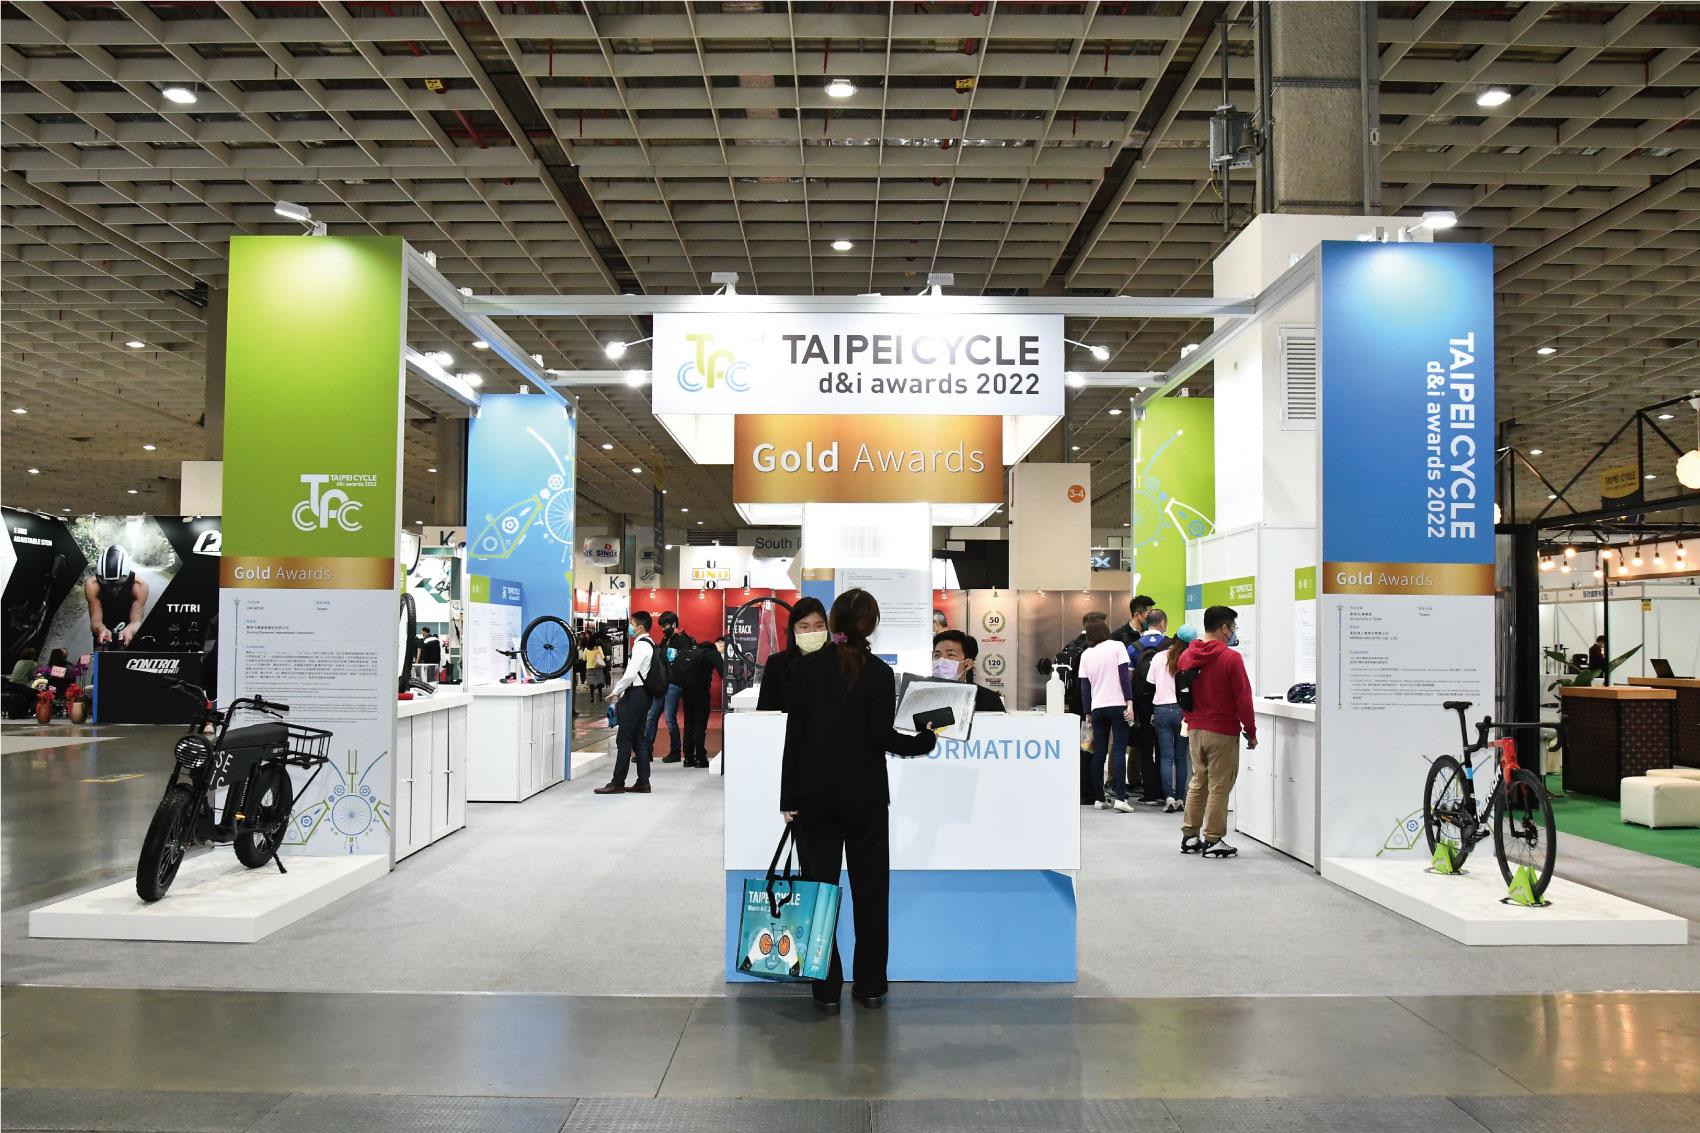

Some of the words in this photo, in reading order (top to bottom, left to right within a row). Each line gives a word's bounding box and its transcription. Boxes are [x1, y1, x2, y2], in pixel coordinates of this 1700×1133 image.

[782, 334, 902, 365] TAIPEI
[911, 334, 1040, 366] CYCLE
[818, 371, 862, 394] d&i
[870, 372, 968, 394] awards
[976, 372, 1040, 395] 2022
[1426, 360, 1445, 397] d&i
[1449, 332, 1475, 430] TAIPEI
[1427, 402, 1445, 480] awards
[751, 440, 840, 474] Gold
[852, 440, 986, 474] Awards
[1069, 488, 1084, 498] 3-4
[1449, 433, 1476, 540] CYCLE
[1427, 487, 1445, 539] 2022
[755, 536, 793, 550] South
[234, 566, 271, 580] Gold
[275, 566, 332, 581] Awards
[610, 576, 620, 589] K
[1336, 571, 1374, 586] Gold
[1378, 571, 1434, 587] Awards
[167, 604, 201, 613] TT/TRI
[891, 738, 1062, 760] ORMATION
[749, 891, 770, 904] TAIPE
[776, 892, 801, 906] CYLE
